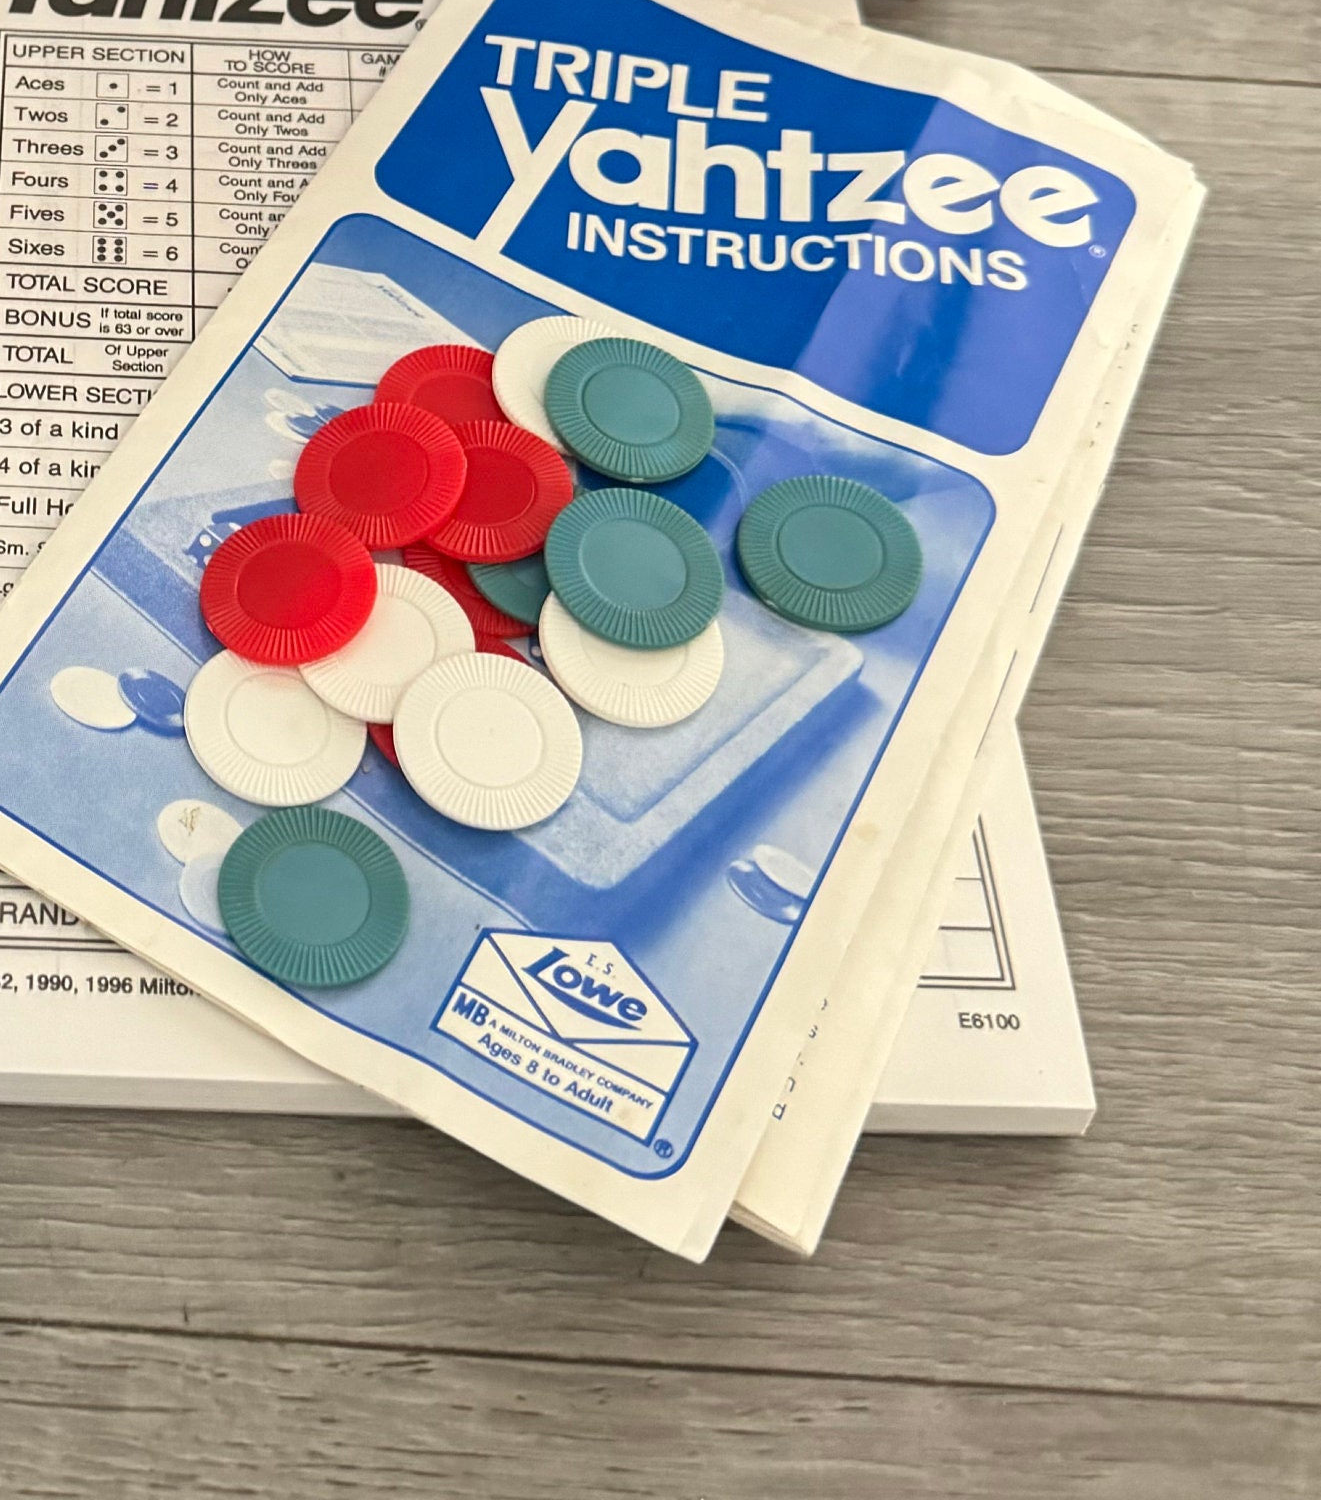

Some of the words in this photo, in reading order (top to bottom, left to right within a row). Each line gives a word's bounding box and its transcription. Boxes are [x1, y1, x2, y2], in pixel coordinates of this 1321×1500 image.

[12, 43, 85, 60] UPPER
[91, 47, 185, 64] SECTION
[248, 49, 291, 62] HOW
[360, 52, 401, 66] GAM
[224, 59, 247, 72] TO
[253, 61, 316, 76] SCORE
[15, 75, 65, 91] Aces
[169, 82, 177, 96] 1
[217, 77, 260, 90] Count
[264, 80, 291, 91] and
[295, 81, 324, 92] Add
[483, 33, 772, 124] TRIPLE
[234, 91, 267, 105] Only
[272, 92, 307, 104] Aces
[14, 106, 68, 123] Twos
[165, 113, 178, 127] 2
[217, 109, 260, 121] Count
[265, 112, 292, 122] and
[297, 112, 325, 124] Add
[235, 123, 269, 137] Only
[274, 125, 308, 137] Twos
[12, 138, 84, 156] Threes
[165, 145, 178, 160] 3
[218, 142, 261, 154] Count
[266, 144, 293, 155] and
[298, 145, 326, 157] Add
[228, 156, 262, 170] Only
[267, 157, 317, 170] Threes
[480, 86, 1102, 254] Yahtzee
[11, 171, 69, 188] Fours
[165, 178, 178, 193] 4
[218, 175, 262, 188] Count
[267, 178, 294, 188] and
[234, 189, 268, 203] Only
[273, 190, 300, 203] Fou
[9, 204, 65, 222] Fives
[165, 212, 178, 227] 5
[219, 208, 262, 221] Count
[236, 223, 270, 237] Only
[7, 238, 65, 256] Sixes
[165, 246, 178, 261] 6
[219, 242, 263, 255] Coun
[566, 211, 1029, 292] INSTRUCTIONS
[6, 273, 75, 292] TOTAL
[83, 276, 168, 296] SCORE
[5, 308, 91, 329] BONUS
[100, 307, 109, 318] If
[114, 308, 141, 320] total
[146, 311, 183, 322] score
[99, 322, 110, 333] is
[115, 323, 132, 335] 63
[136, 325, 150, 335] or
[154, 327, 184, 337] over
[2, 344, 74, 364] TOTAL
[105, 344, 122, 356] Of
[127, 345, 169, 360] Upper
[112, 359, 164, 373] Section
[85, 386, 155, 405] SECTI
[20, 419, 42, 436] of
[49, 424, 63, 437] a
[71, 421, 119, 440] kind
[18, 457, 41, 475] of
[48, 463, 62, 476] a
[25, 974, 79, 994] 1990,
[86, 975, 133, 994] 1996
[521, 946, 648, 1026] Lowe
[958, 1011, 1020, 1030] E6100
[451, 991, 490, 1027] MB
[488, 1018, 498, 1029] A
[499, 1025, 542, 1054] MILTON
[542, 1049, 595, 1080] BRADLEY
[596, 1076, 654, 1110] COMPANY
[478, 1032, 522, 1066] Ages
[526, 1058, 539, 1075] 8
[542, 1068, 561, 1086] to
[564, 1080, 614, 1113] Adult
